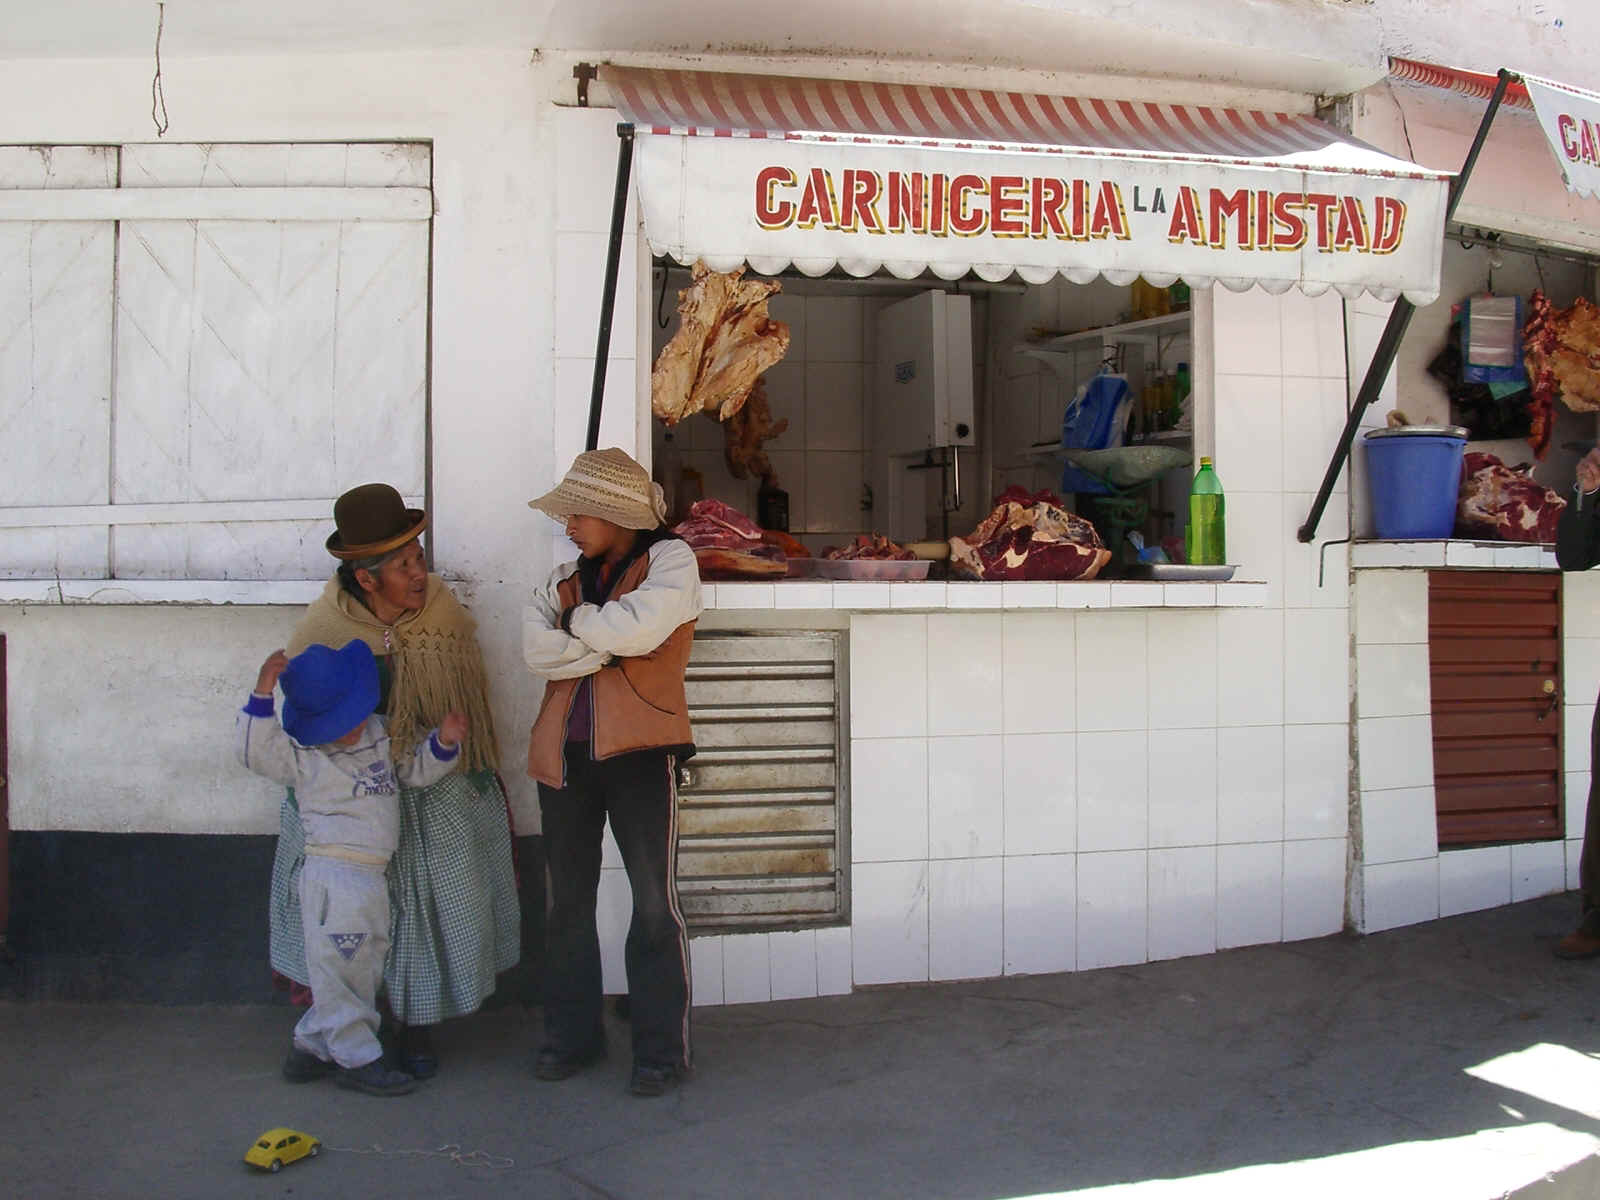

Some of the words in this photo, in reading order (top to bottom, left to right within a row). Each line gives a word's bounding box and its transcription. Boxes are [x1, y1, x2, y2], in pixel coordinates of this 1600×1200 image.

[1558, 114, 1600, 168] CA
[755, 166, 1131, 242] CARNICERIA
[1133, 185, 1167, 214] LA
[1167, 185, 1407, 255] AMISTAD
